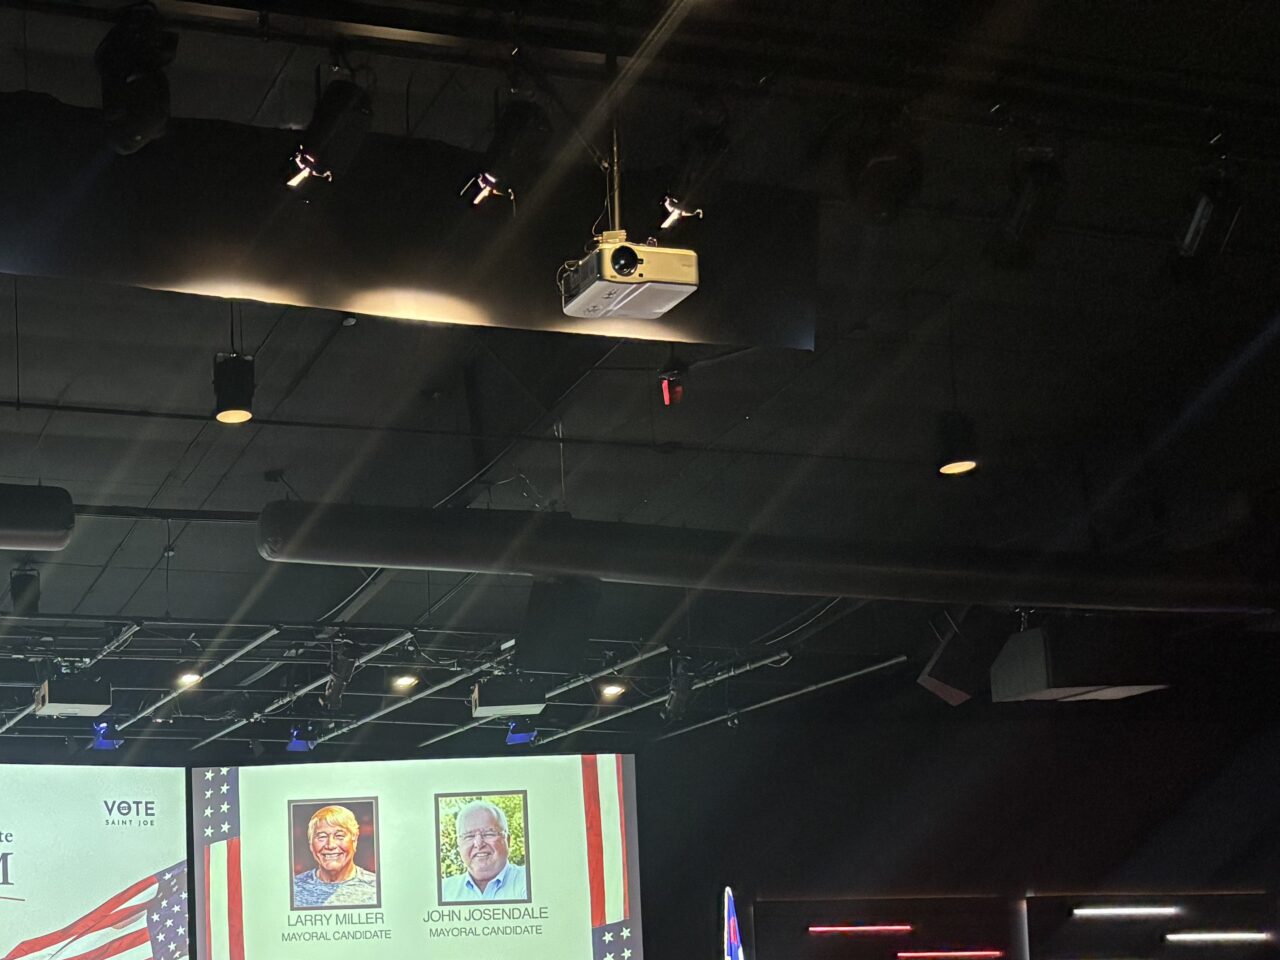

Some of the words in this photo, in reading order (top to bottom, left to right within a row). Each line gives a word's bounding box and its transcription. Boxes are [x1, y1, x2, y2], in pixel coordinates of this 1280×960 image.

[103, 800, 156, 816] VOTE
[138, 819, 155, 827] JOE
[287, 914, 332, 927] LARRY
[335, 912, 385, 925] MILLER
[423, 909, 461, 922] JOHN
[464, 906, 549, 921] JOSENDALE
[281, 931, 332, 942] MAYORAL
[332, 929, 392, 941] CANDIDATE
[429, 927, 481, 938] MAYORAL
[482, 925, 543, 937] CANDIDATE
